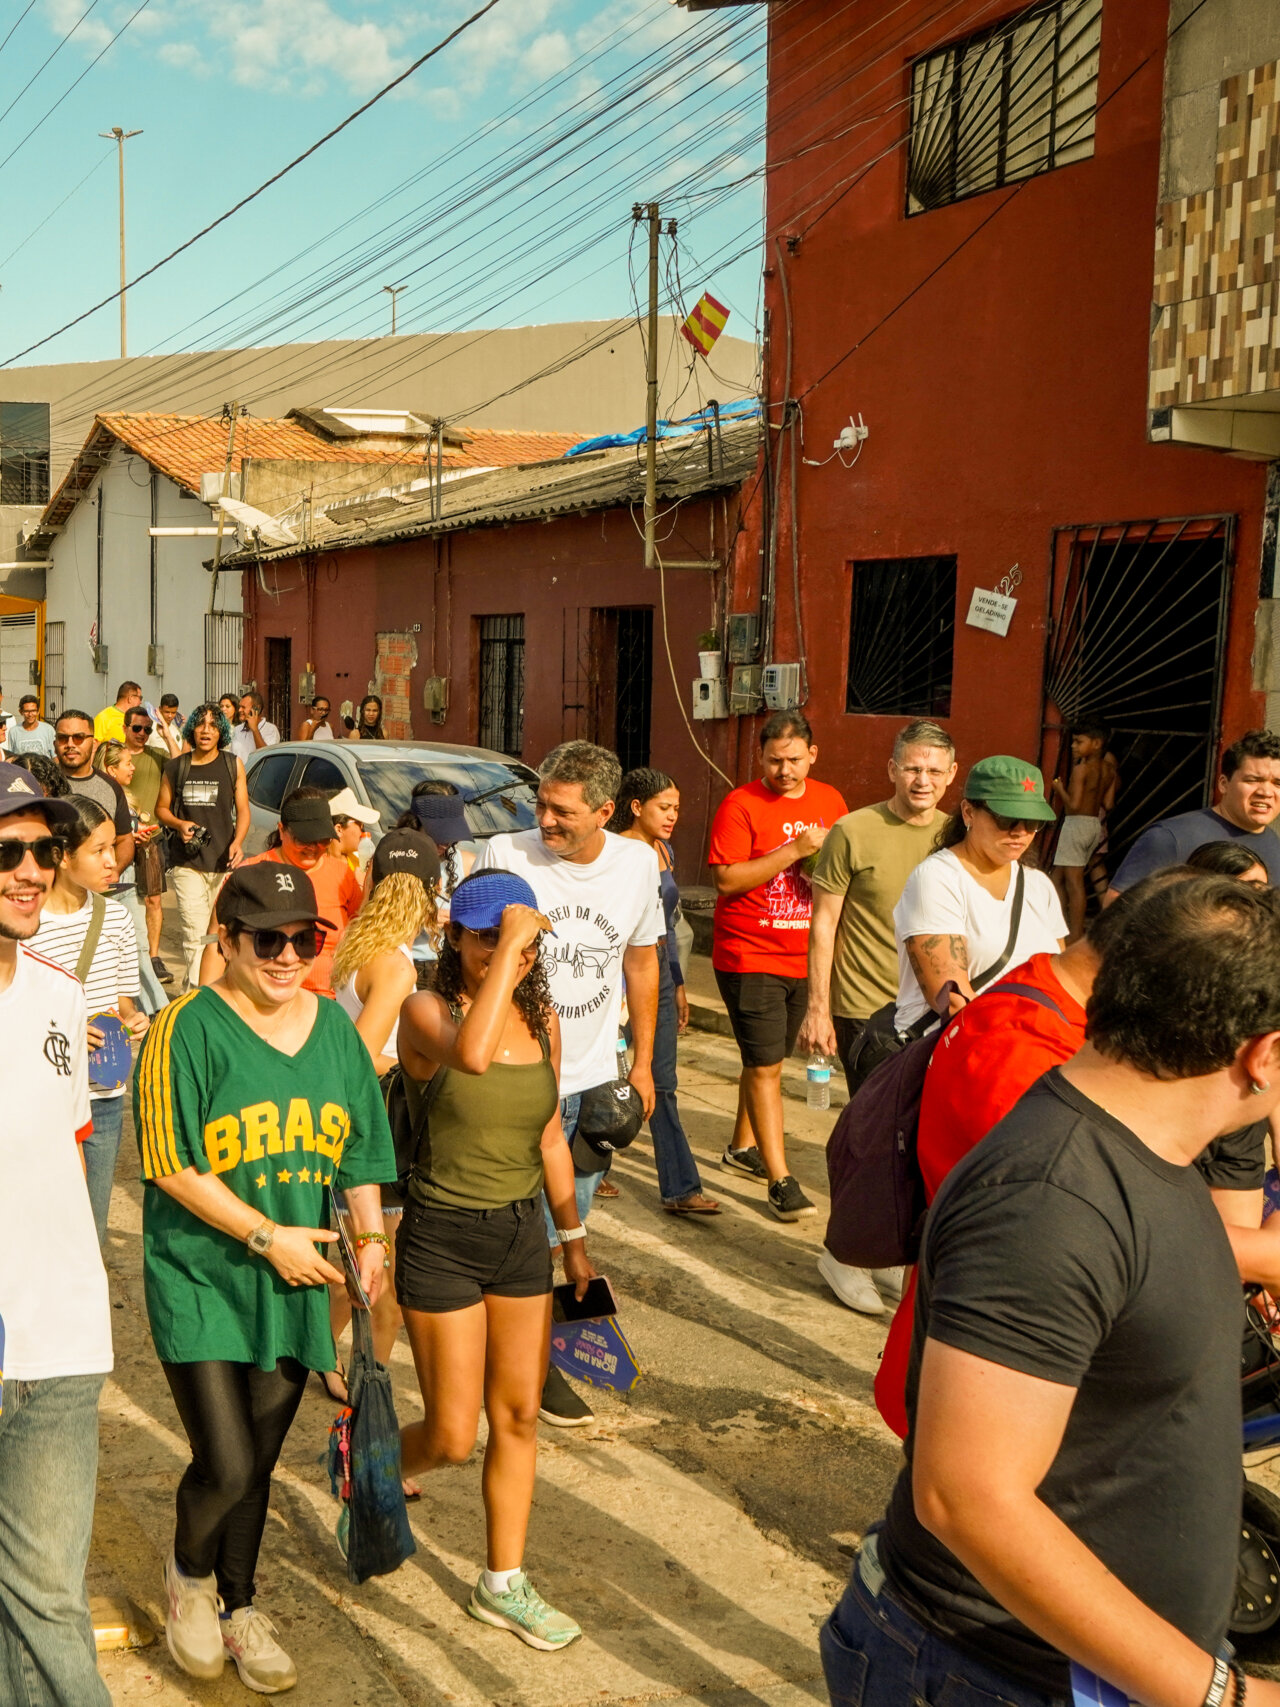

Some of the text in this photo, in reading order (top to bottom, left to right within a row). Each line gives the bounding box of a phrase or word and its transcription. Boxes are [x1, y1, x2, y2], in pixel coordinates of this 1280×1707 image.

[974, 605, 1007, 621] GELADINHO
[576, 905, 590, 921] DA
[204, 1098, 351, 1175] BRAS
